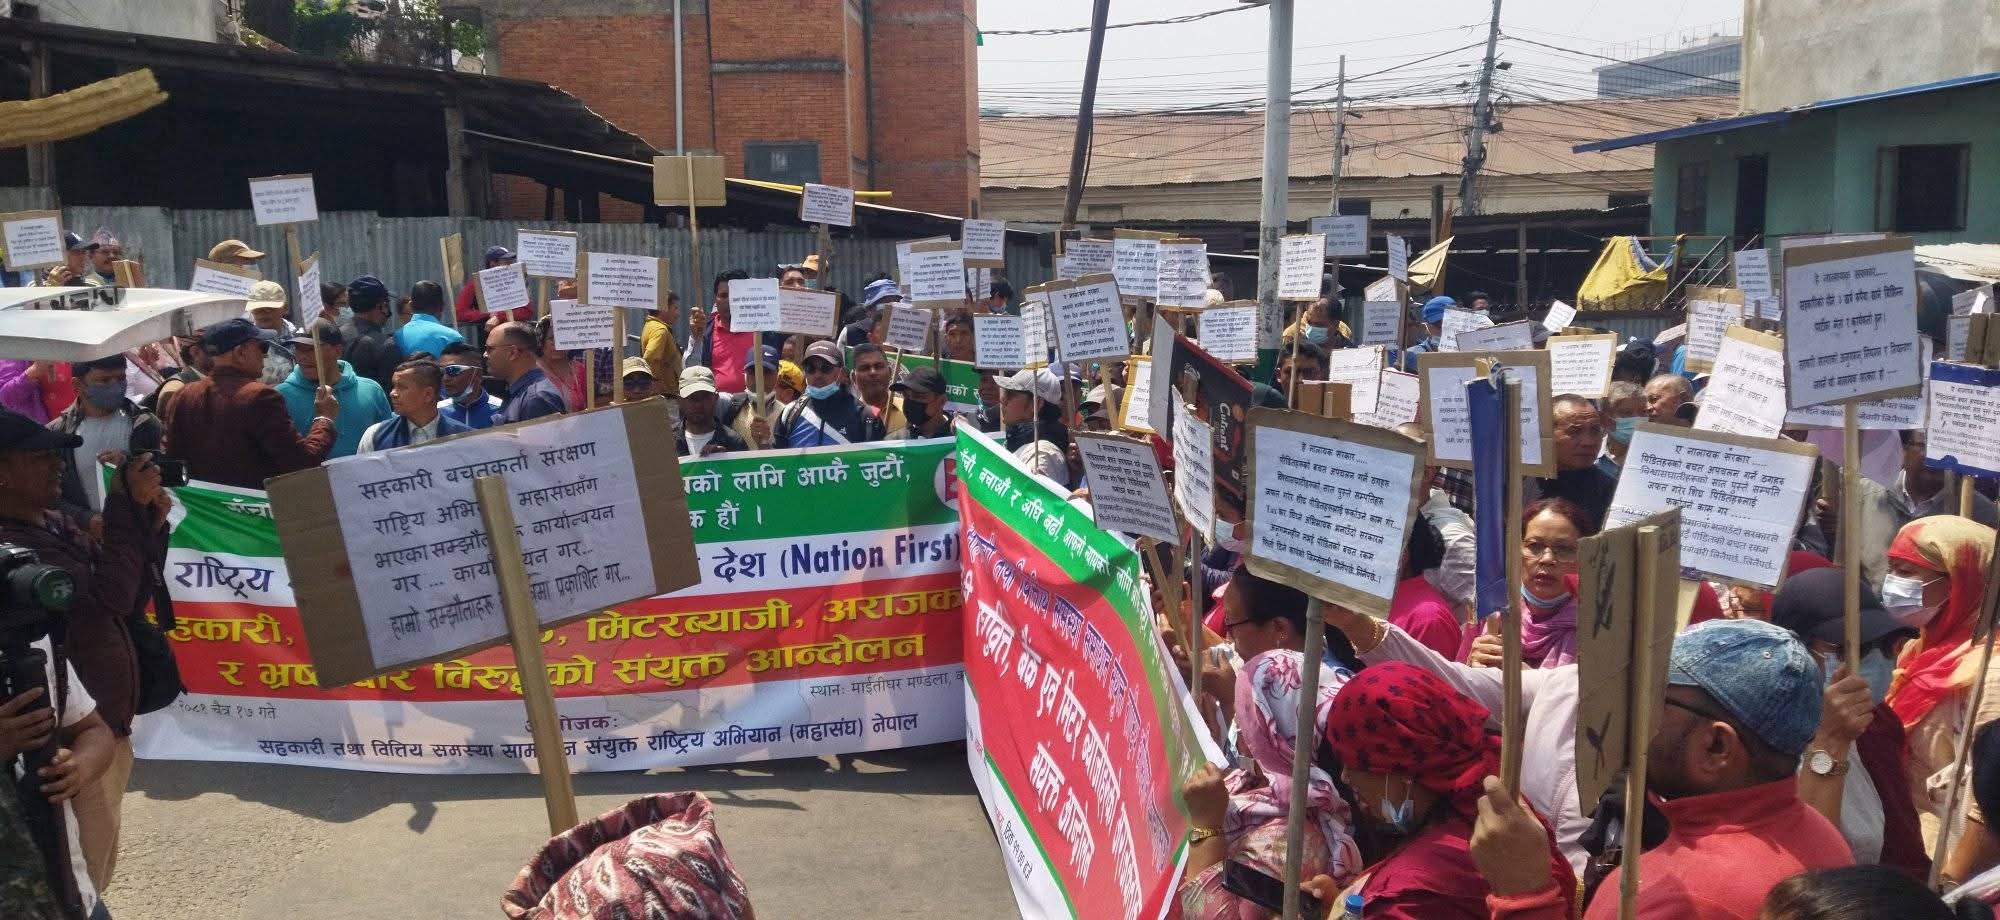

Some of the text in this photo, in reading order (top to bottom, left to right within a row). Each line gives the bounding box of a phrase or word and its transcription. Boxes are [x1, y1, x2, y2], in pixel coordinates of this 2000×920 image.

[1308, 443, 1334, 457] नालायक
[1685, 459, 1704, 474] बचत
[1686, 445, 1722, 459] नालायक
[358, 469, 434, 501] सहकारी
[540, 440, 597, 468] संरक्षण
[732, 463, 786, 493] लागि
[797, 456, 850, 488] आफै
[1647, 480, 1667, 494] जफत
[1710, 476, 1727, 490] सात
[372, 504, 426, 537] राष्ट्रिय
[517, 474, 599, 507] महासंघसँग
[1697, 499, 1714, 514] काम
[374, 538, 431, 568] भएका
[531, 502, 617, 535] कार्यान्वयन
[174, 556, 275, 599] राष्ट्रिय
[712, 546, 768, 584] देश
[779, 540, 885, 580] (Nation
[145, 611, 295, 647] हकारी,
[217, 660, 245, 687] र
[612, 651, 731, 689] संयुक्त
[744, 633, 928, 676] आन्दोलन
[258, 702, 278, 720] गते
[257, 738, 326, 756] सहकारी
[331, 743, 366, 756] तथा
[430, 744, 495, 758] समस्या
[584, 736, 639, 759] संयुक्त
[647, 730, 706, 757] राष्ट्रिय
[713, 724, 782, 746] अभियान
[789, 717, 864, 743] (महासंघ)
[872, 712, 919, 734] नेपाल
